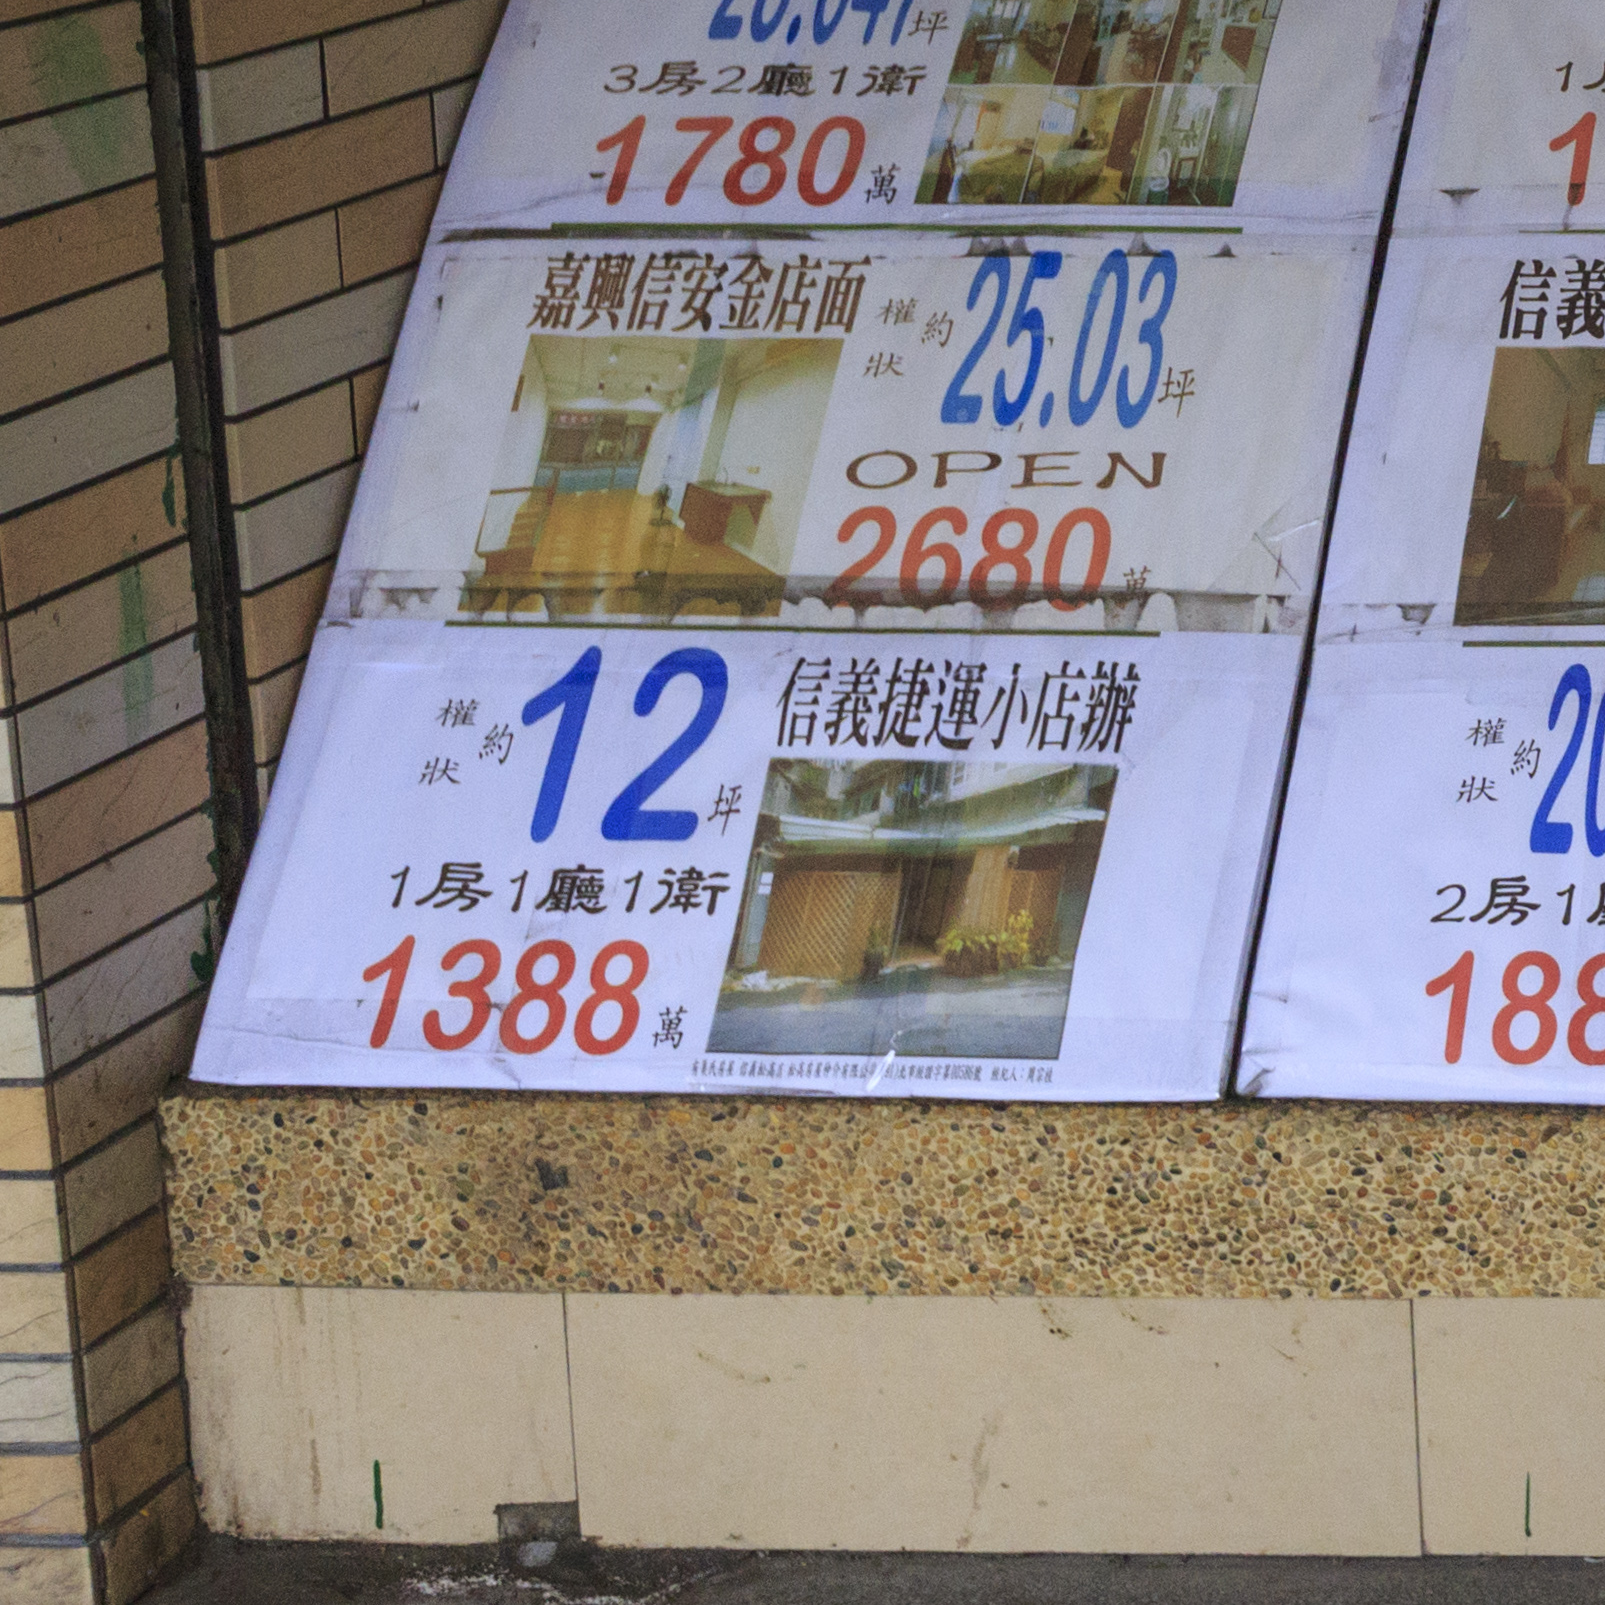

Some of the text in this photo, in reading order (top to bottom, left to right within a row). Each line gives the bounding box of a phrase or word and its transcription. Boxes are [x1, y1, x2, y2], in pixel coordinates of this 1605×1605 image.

[909, 9, 950, 47] 坪
[604, 61, 927, 99] 3房2廳1衛
[597, 114, 901, 207] 1780 萬
[527, 251, 871, 333] 嘉興信安金店面
[921, 313, 954, 349] 約
[939, 249, 1177, 429] 25.03
[1156, 366, 1196, 417] 坪
[845, 451, 1167, 490] OPEN
[835, 505, 1112, 612] 2680
[479, 724, 514, 765] 約
[521, 644, 729, 843] 12
[707, 783, 744, 837] 坪
[775, 657, 1142, 754] 信義捷運小店辦
[1509, 736, 1541, 777] 約
[390, 861, 730, 916] 1房1廳1衛
[362, 934, 687, 1055] 1388 萬
